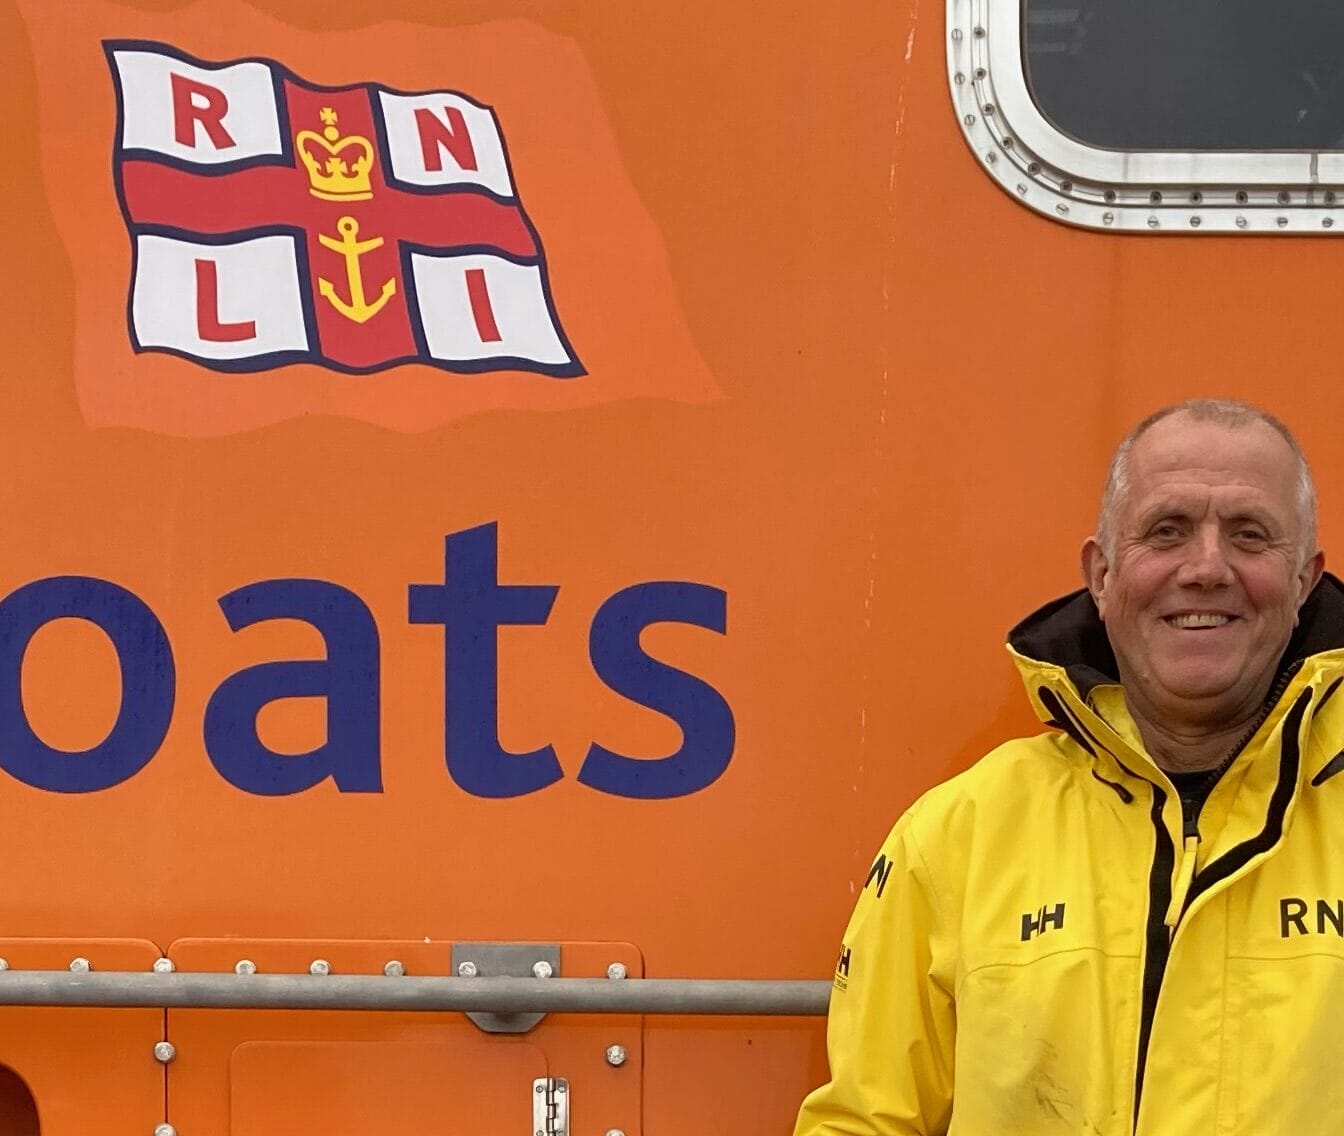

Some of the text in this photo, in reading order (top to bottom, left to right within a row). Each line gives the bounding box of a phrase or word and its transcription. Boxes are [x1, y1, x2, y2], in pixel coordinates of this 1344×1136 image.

[169, 72, 478, 172] R N
[194, 258, 503, 343] L I
